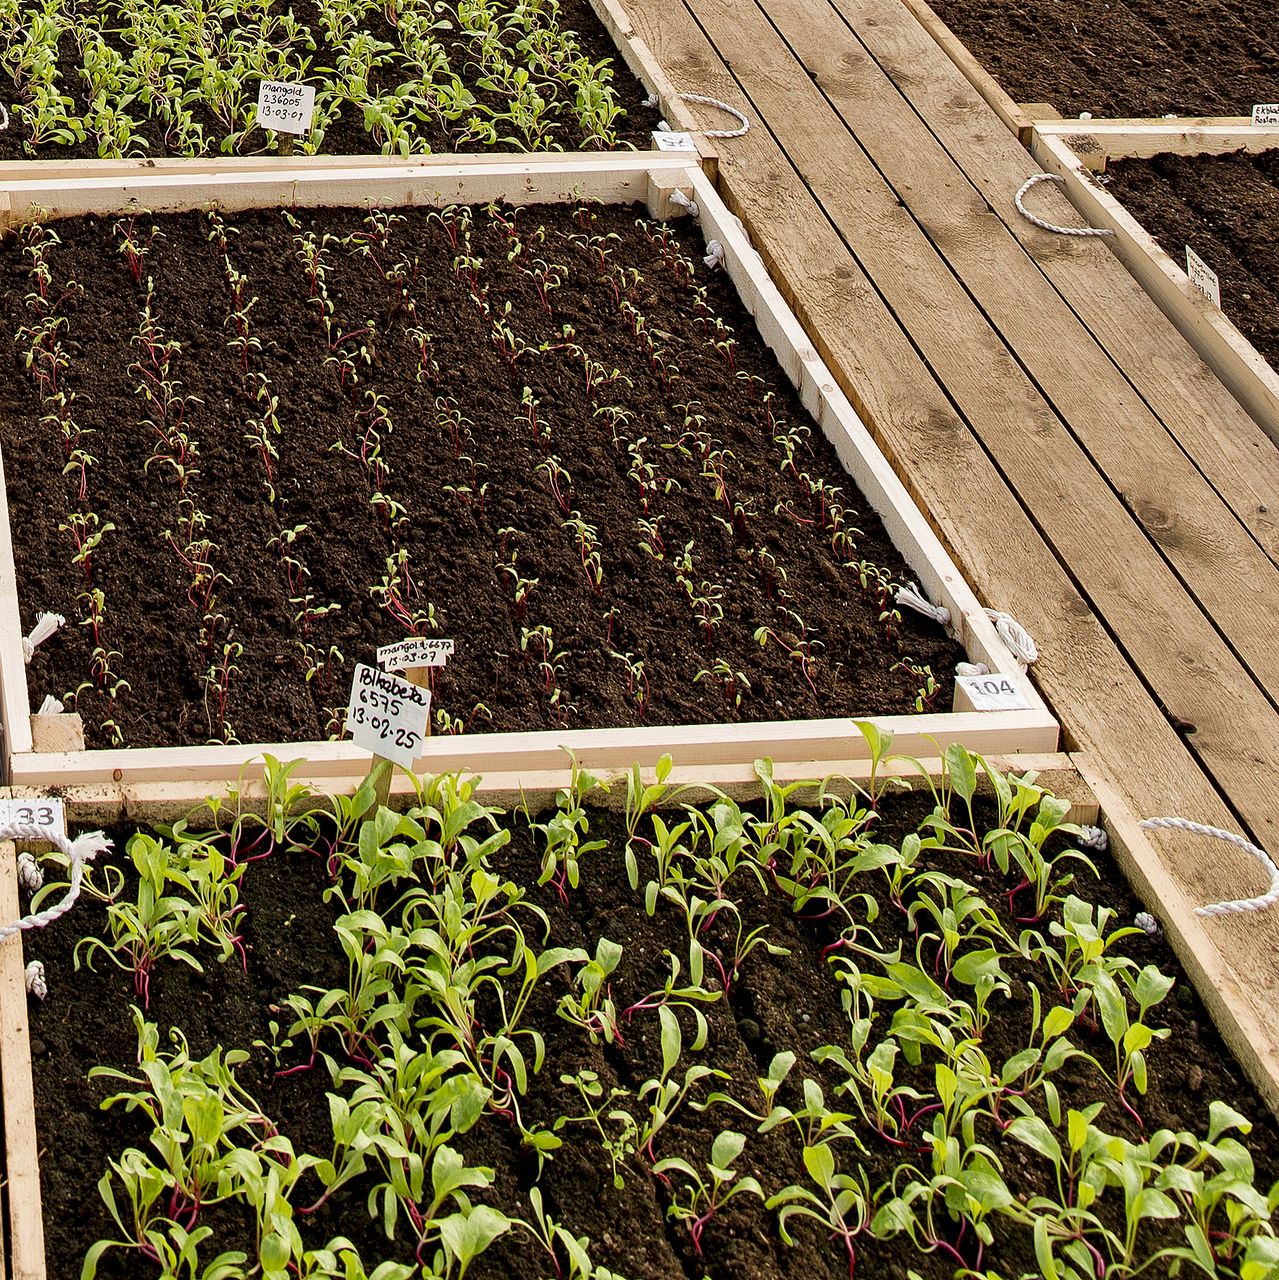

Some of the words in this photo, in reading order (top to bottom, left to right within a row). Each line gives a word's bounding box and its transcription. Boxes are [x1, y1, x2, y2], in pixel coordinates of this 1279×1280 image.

[263, 83, 304, 97] mangold
[263, 94, 302, 107] 236005
[360, 668, 427, 707] Polkabeta
[970, 680, 1015, 696] 104
[359, 688, 404, 716] 6575
[16, 807, 55, 826] 33
